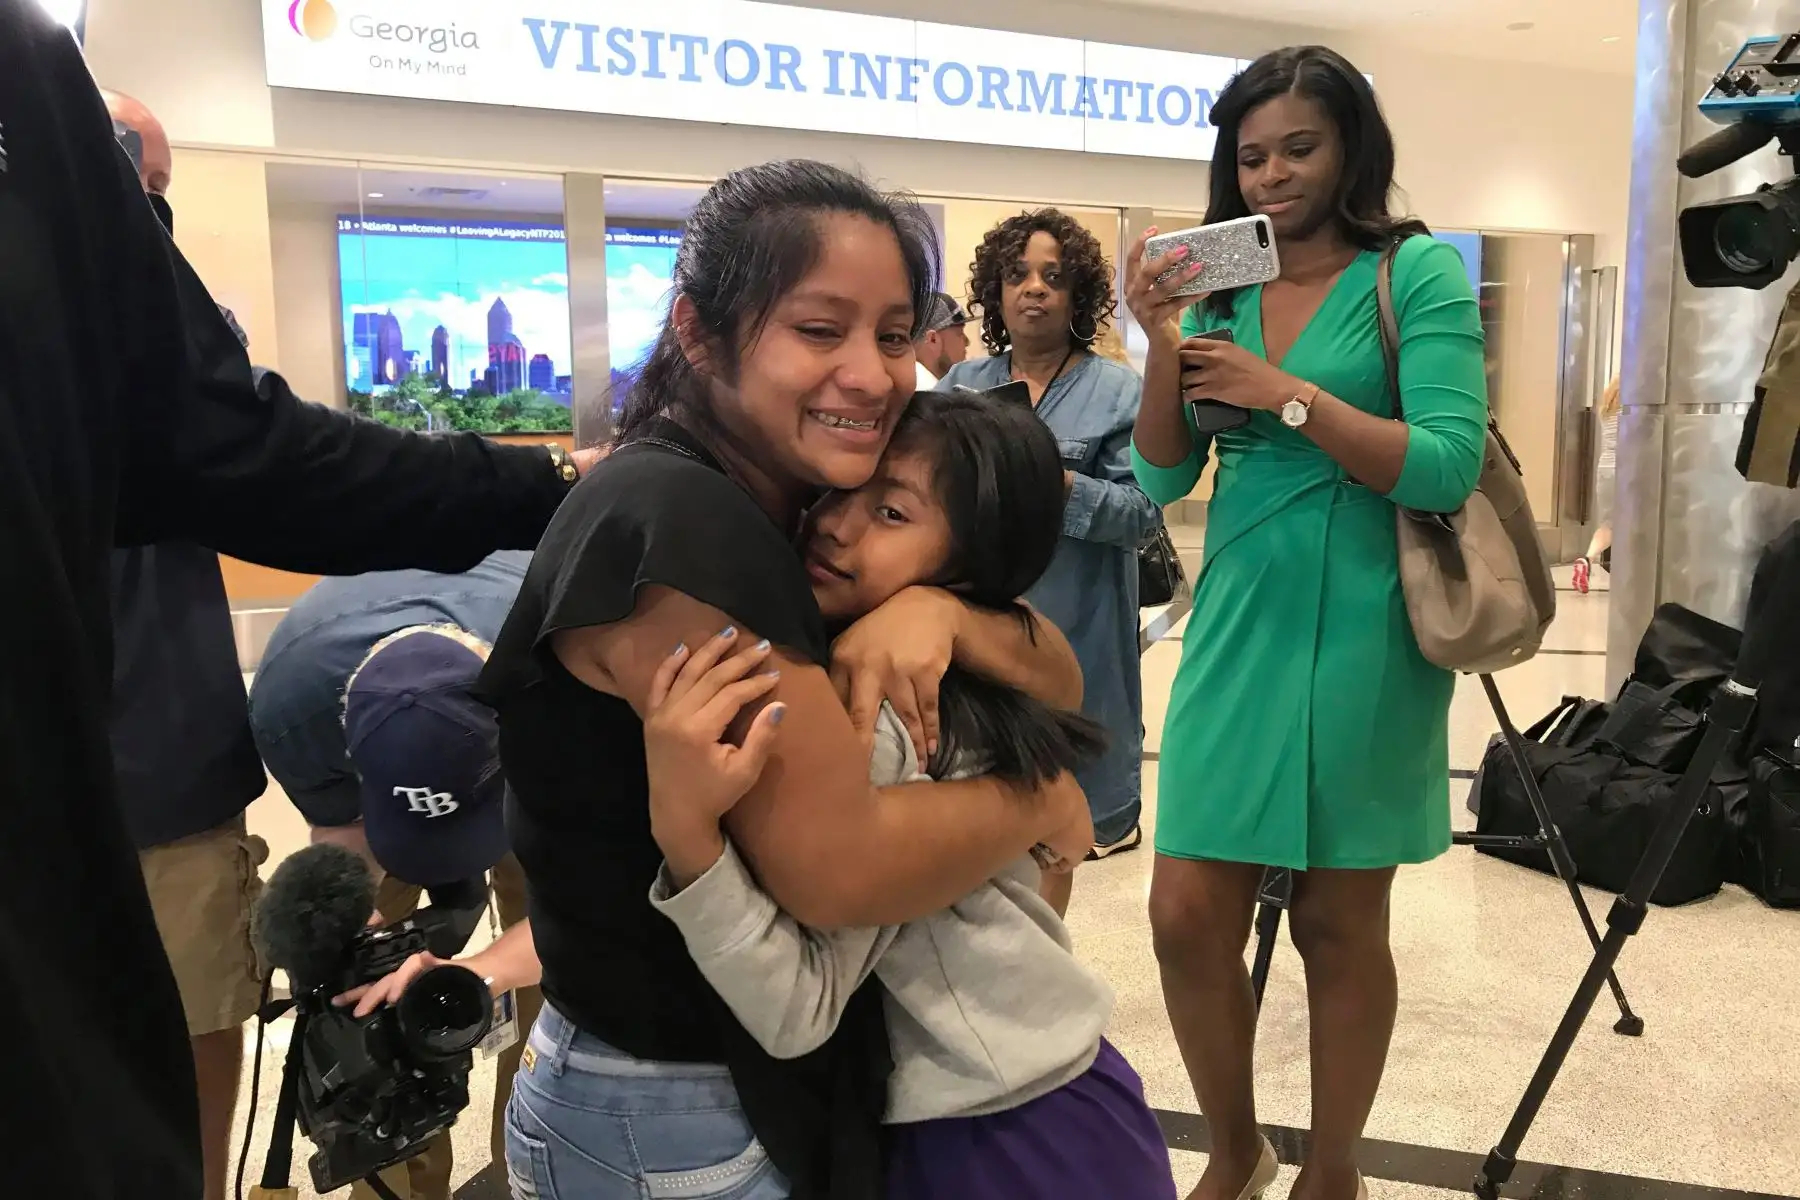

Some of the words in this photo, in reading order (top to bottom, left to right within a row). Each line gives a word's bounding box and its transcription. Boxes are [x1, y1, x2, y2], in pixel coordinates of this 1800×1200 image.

[349, 14, 480, 53] Georgia
[369, 54, 394, 69] On
[398, 57, 421, 75] My
[427, 60, 466, 76] Mind
[522, 17, 807, 93] VISITOR
[822, 48, 1222, 129] INFORMATION
[361, 221, 397, 232] Atlanta
[399, 224, 447, 234] welcomes
[392, 786, 460, 818] TB
